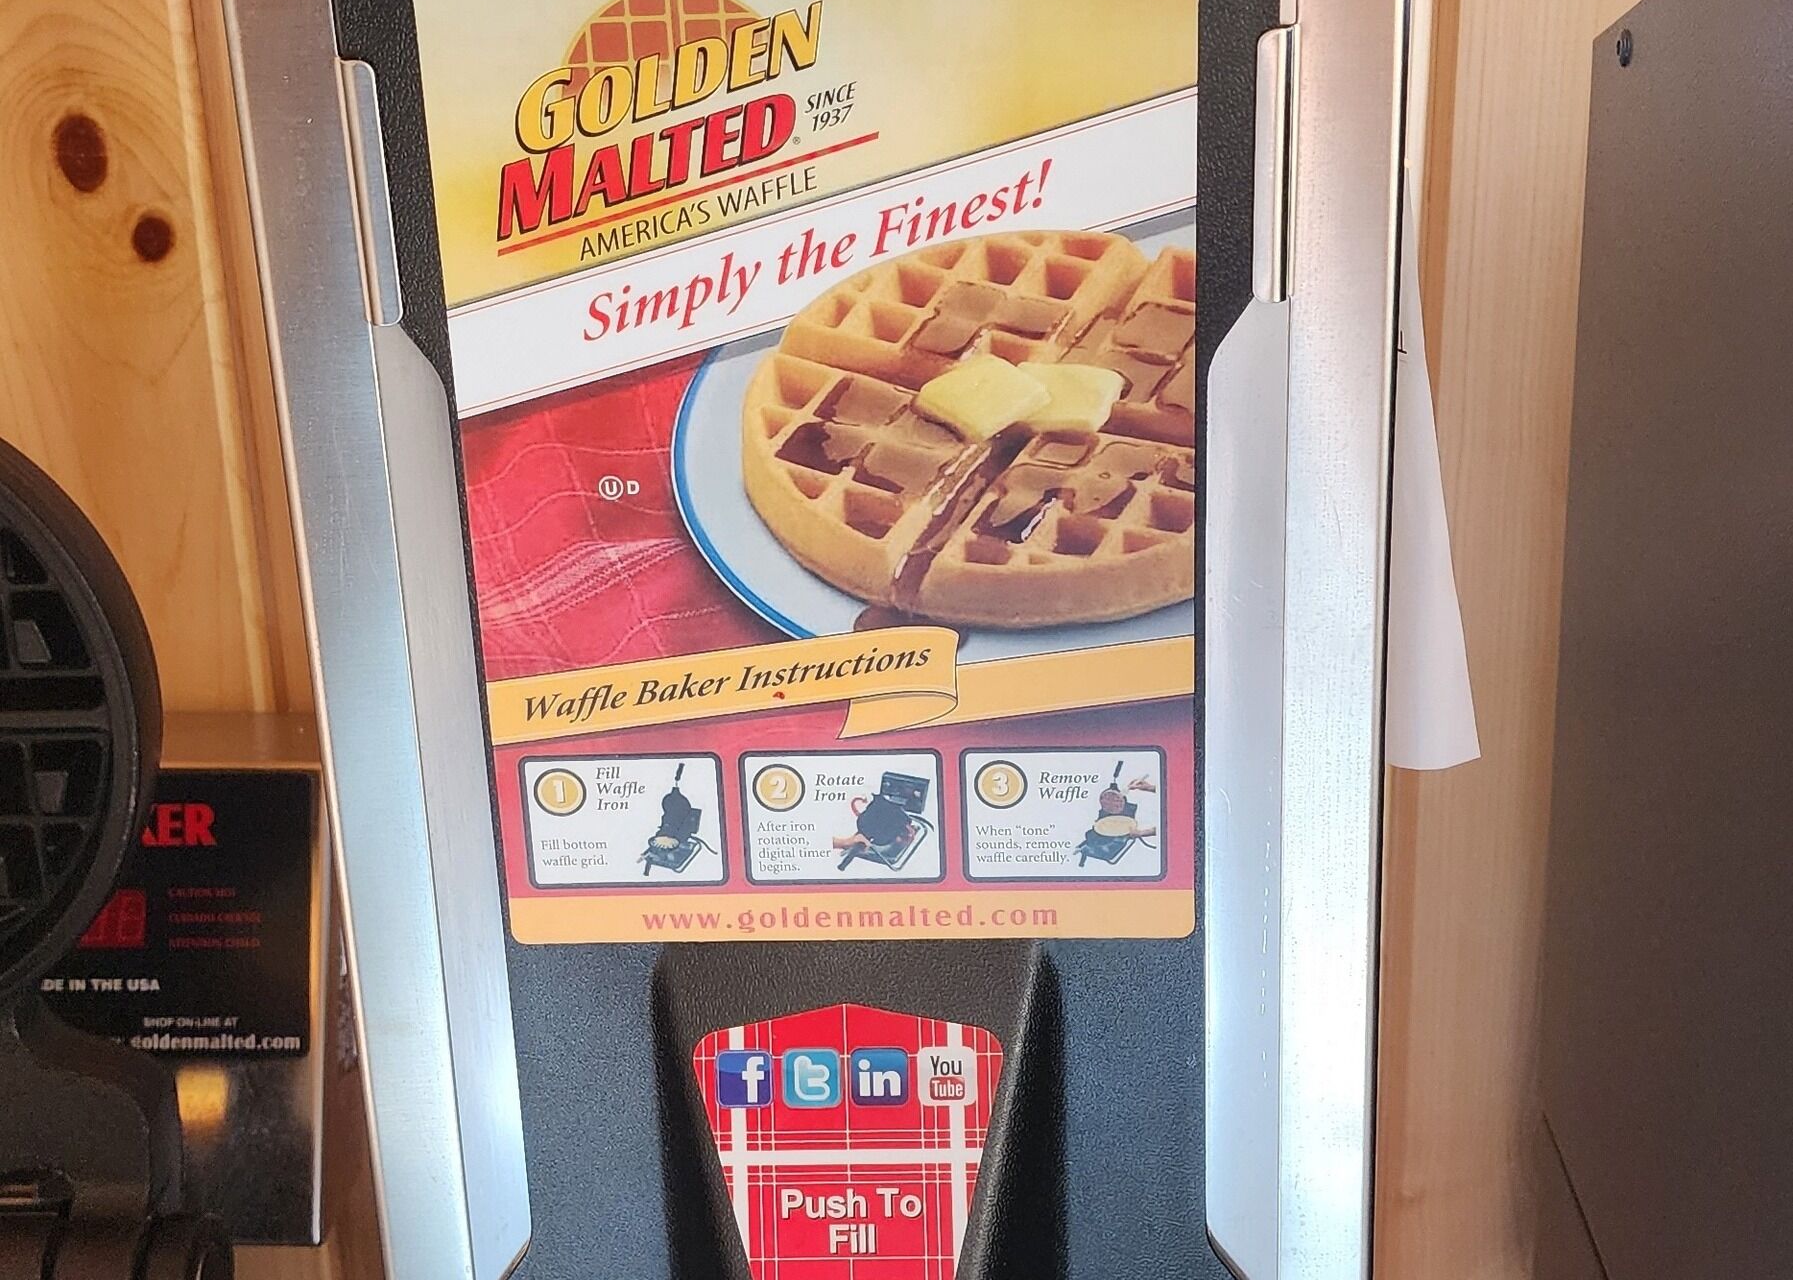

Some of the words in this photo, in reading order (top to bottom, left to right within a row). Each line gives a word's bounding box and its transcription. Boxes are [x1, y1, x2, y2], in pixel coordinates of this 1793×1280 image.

[514, 0, 824, 154] GOLDEN
[804, 81, 857, 113] SINCE
[812, 103, 854, 132] 1937
[496, 92, 796, 241] MALTED
[579, 201, 710, 262] AMERICA'S
[717, 166, 818, 222] WAFFLE
[582, 254, 764, 341] Simply
[776, 228, 854, 284] the
[869, 159, 1053, 258] Finest!
[627, 480, 640, 495] D
[524, 685, 625, 724] Waffle
[632, 671, 731, 708] Baker
[735, 645, 931, 692] Instructions
[595, 767, 620, 779] Fill
[815, 774, 864, 786] Rotate
[1039, 771, 1099, 785] Remove
[553, 780, 566, 803] 1
[596, 782, 646, 798] Waffle
[769, 775, 788, 800] 2
[992, 771, 1009, 796] 3
[814, 789, 847, 802] Iron
[1039, 786, 1089, 802] Waffle
[597, 798, 629, 811] Iron
[141, 801, 217, 847] ER
[757, 821, 787, 832] After
[790, 821, 816, 832] iron
[976, 825, 1012, 836] When
[541, 840, 560, 851] Fill
[562, 839, 607, 850] bottom
[758, 834, 810, 846] rotation,
[976, 838, 1022, 850] sounds,
[1025, 840, 1071, 850] remove
[542, 855, 577, 867] waffle
[581, 855, 608, 869] grid.
[758, 847, 796, 861] digital
[799, 847, 831, 859] timer
[976, 852, 1012, 863] waffle
[1015, 851, 1070, 865] carefully.
[759, 861, 801, 875] begins.
[642, 904, 1059, 934] www.goldenmalted.com
[40, 978, 64, 991] DE
[68, 978, 86, 991] IN
[90, 978, 123, 991] THE
[127, 978, 160, 991] USA
[930, 1055, 963, 1076] You
[858, 1058, 901, 1098] in
[931, 1079, 964, 1099] Tube
[780, 1188, 867, 1220] Push
[876, 1187, 923, 1218] To
[828, 1223, 877, 1255] Fill
